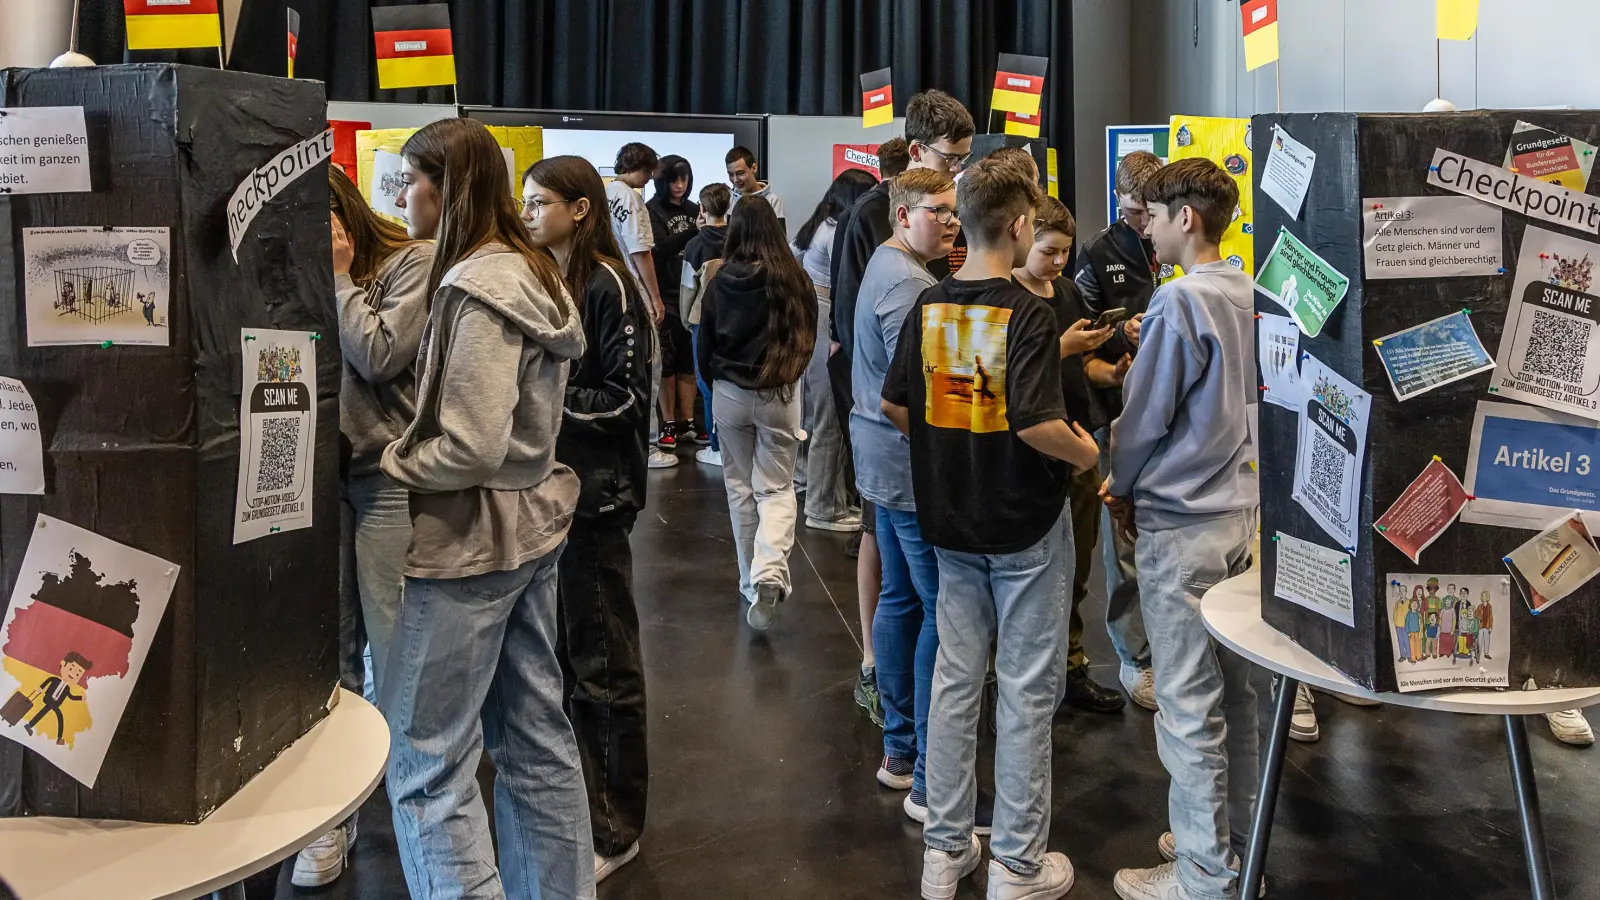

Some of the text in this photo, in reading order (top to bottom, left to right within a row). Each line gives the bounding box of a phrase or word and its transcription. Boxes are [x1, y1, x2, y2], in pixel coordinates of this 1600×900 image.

[34, 134, 86, 147] genießen
[1516, 136, 1568, 151] Grundgesetz
[21, 154, 35, 164] im
[39, 156, 80, 166] ganzen
[1526, 155, 1569, 169] Bundesrepublik
[1536, 151, 1545, 159] für
[1533, 164, 1568, 176] Deutschland
[228, 131, 332, 240] heckpoint
[1437, 156, 1597, 228] Checkpoint
[1374, 210, 1414, 220] Artikel 3:
[1374, 225, 1496, 237] Alle Menschen sind vor dem
[1375, 240, 1480, 253] Getz gleich. Männer und
[1280, 248, 1292, 263] sind
[1376, 255, 1499, 267] Frauen sind gleichberechtigt.
[1106, 263, 1126, 272] JAKO
[1283, 237, 1304, 261] Männer
[1304, 257, 1316, 271] und
[1315, 264, 1338, 290] Frauen
[1543, 287, 1592, 314] SCAN ME
[1517, 372, 1583, 395] STOP-MOTION-VIDEO
[264, 388, 298, 406] SCAN ME
[1501, 378, 1597, 410] ZUM GRUNDGESETZ ARTIKEL 3
[8, 399, 34, 412] Jeder
[1, 421, 37, 432] en, wo
[1318, 408, 1346, 442] SCAN ME
[1493, 445, 1591, 476] Artikel 3
[1549, 486, 1560, 494] Das
[241, 510, 251, 523] ZUM
[251, 504, 281, 521] GRUNDGESETZ
[280, 502, 299, 515] ARTIKEL
[1330, 516, 1347, 535] ARTIKEL
[1347, 529, 1352, 539] 3
[1547, 550, 1578, 585] GRUNDGESETZ
[1487, 676, 1506, 684] gleich!
